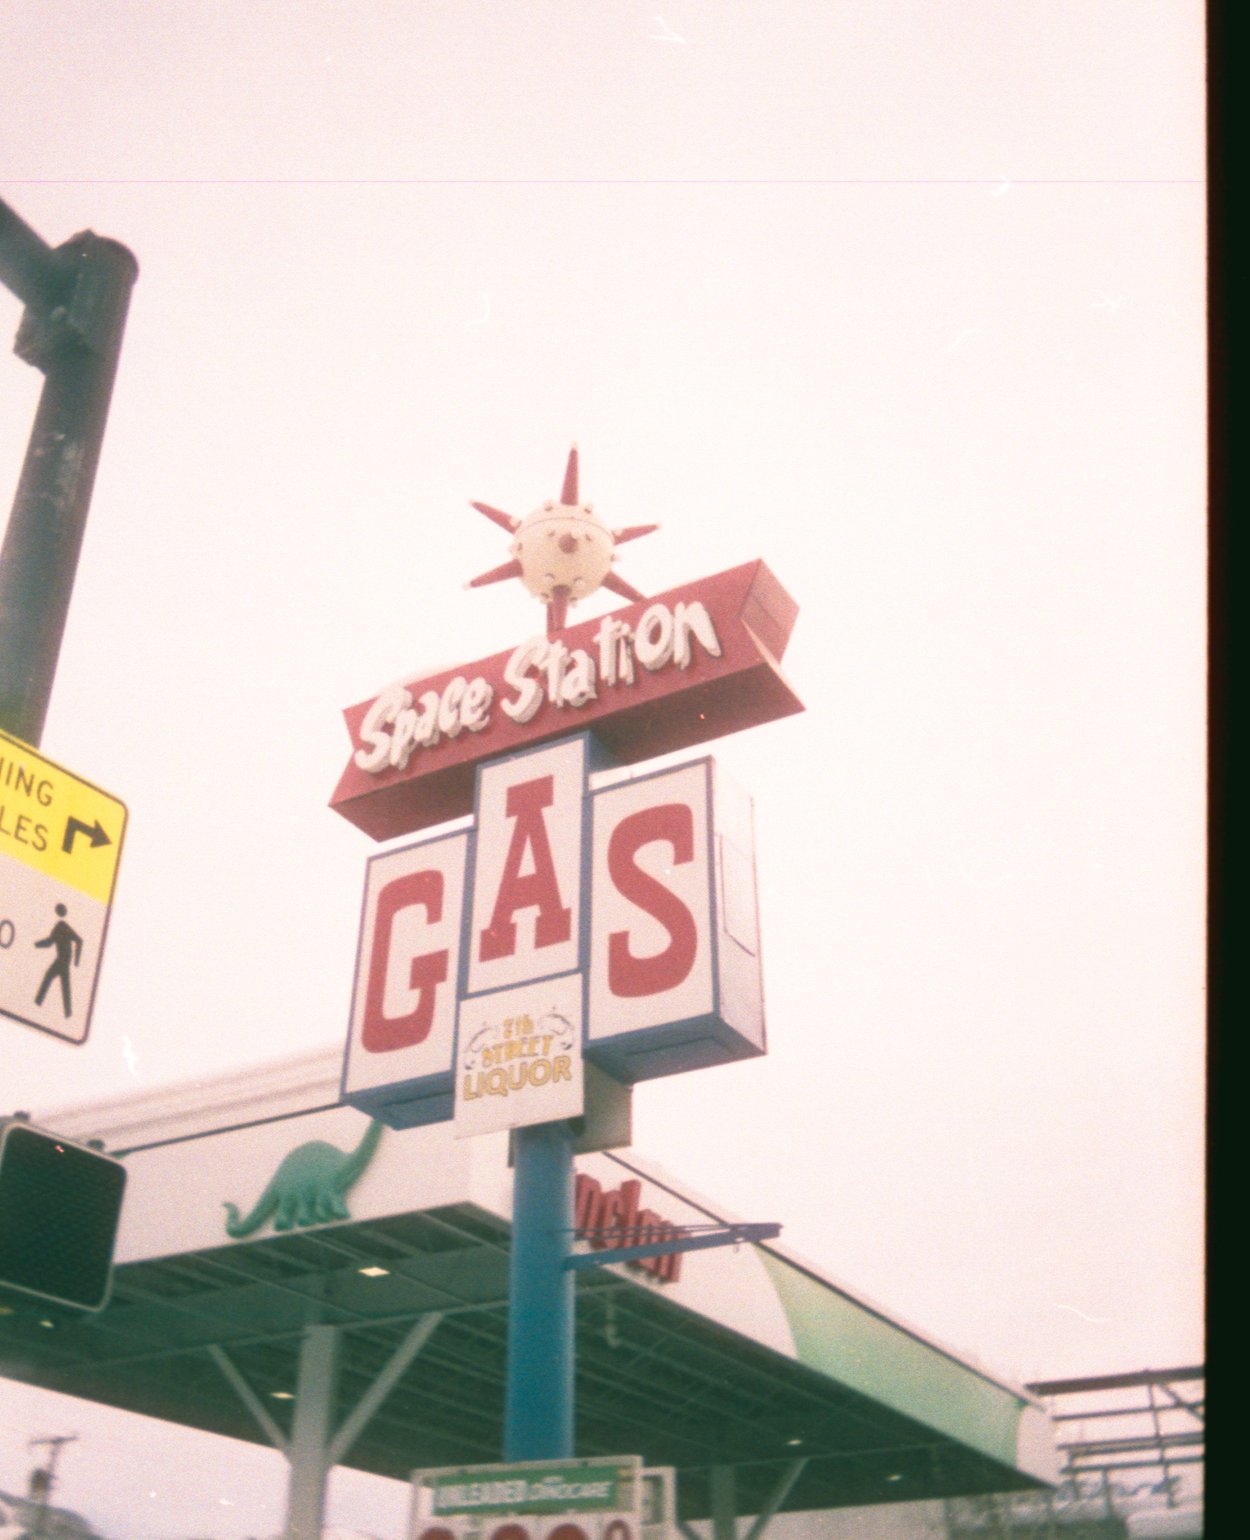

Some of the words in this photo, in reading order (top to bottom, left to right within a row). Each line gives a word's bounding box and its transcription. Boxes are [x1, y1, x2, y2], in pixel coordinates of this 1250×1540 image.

[354, 682, 493, 775] Space
[500, 601, 723, 724] Station
[0, 757, 54, 807] ING
[361, 774, 698, 1054] GAS
[481, 1034, 555, 1068] STREET
[462, 1055, 573, 1101] LIQUOR
